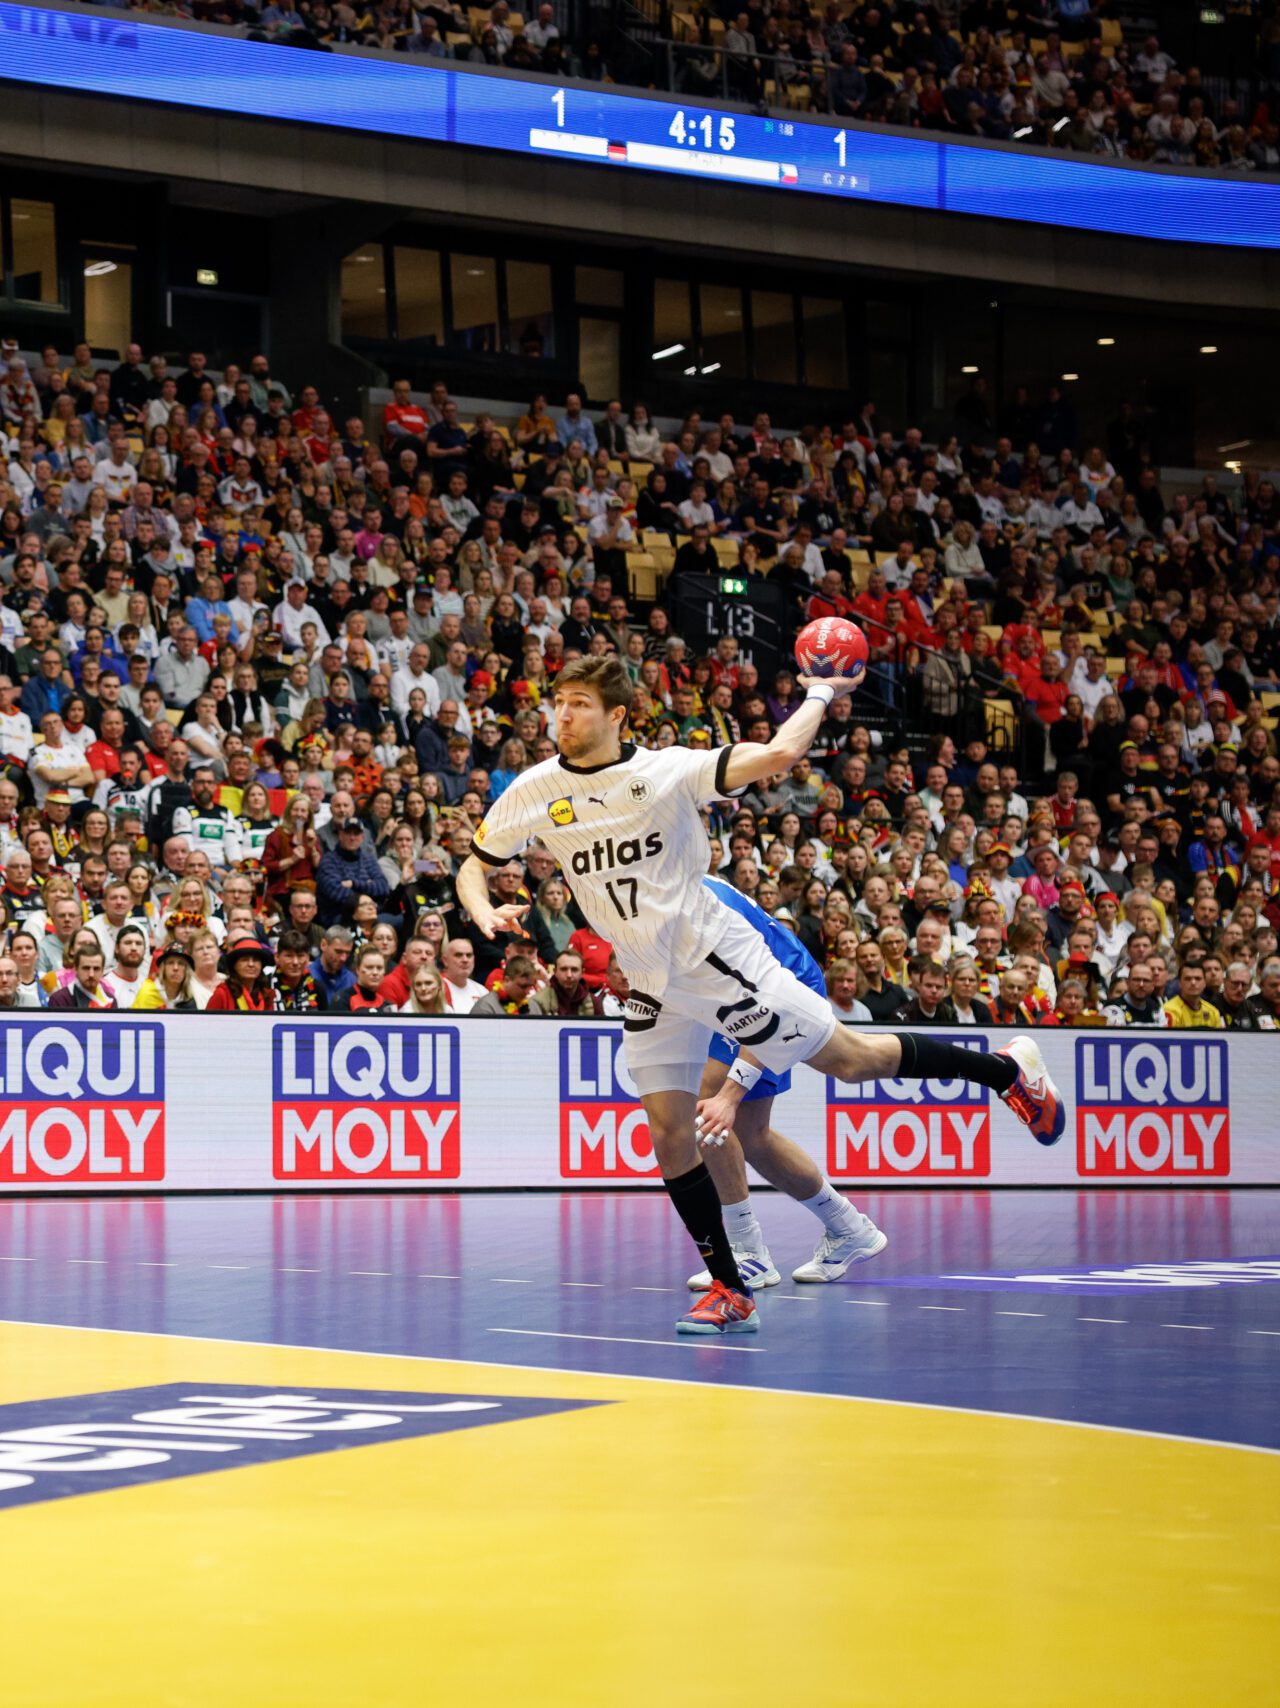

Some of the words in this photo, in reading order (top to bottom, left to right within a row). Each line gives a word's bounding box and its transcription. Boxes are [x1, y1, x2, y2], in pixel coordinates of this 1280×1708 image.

[551, 88, 565, 127] 1
[669, 111, 735, 150] 4:15
[833, 129, 846, 167] 1
[707, 601, 755, 637] L13
[572, 832, 663, 875] atlas
[605, 877, 639, 920] 17
[726, 1005, 770, 1035] HARTING
[282, 1030, 451, 1100] LIQUI
[1083, 1042, 1221, 1106] LIQUI
[282, 1107, 457, 1173] MOLY
[569, 1108, 659, 1173] MO
[835, 1110, 987, 1172] MOLY
[1083, 1112, 1227, 1172] MOLY
